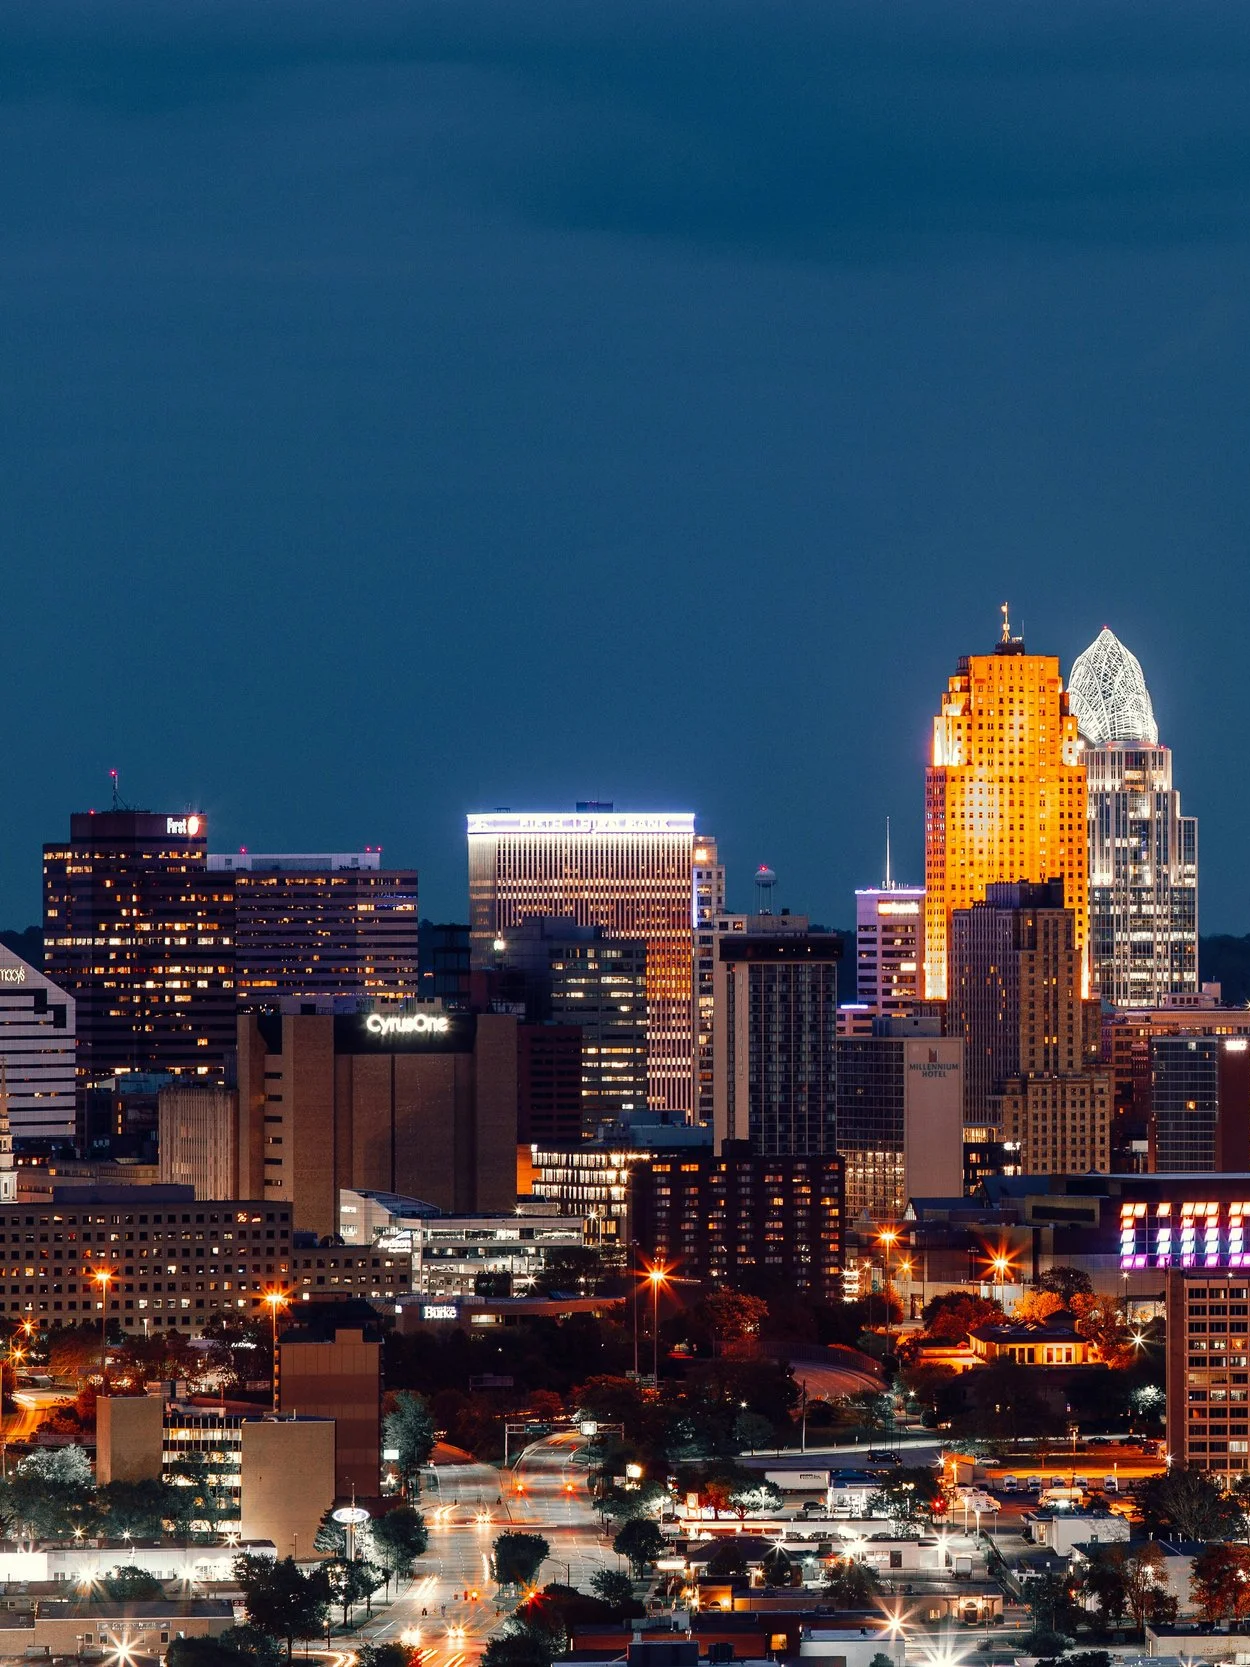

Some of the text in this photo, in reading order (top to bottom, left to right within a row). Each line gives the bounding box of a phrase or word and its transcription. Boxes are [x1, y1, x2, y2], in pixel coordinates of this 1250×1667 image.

[367, 1014, 448, 1035] CyrusOne
[909, 1063, 960, 1071] MILLENNIUM
[423, 1305, 457, 1319] Burke
